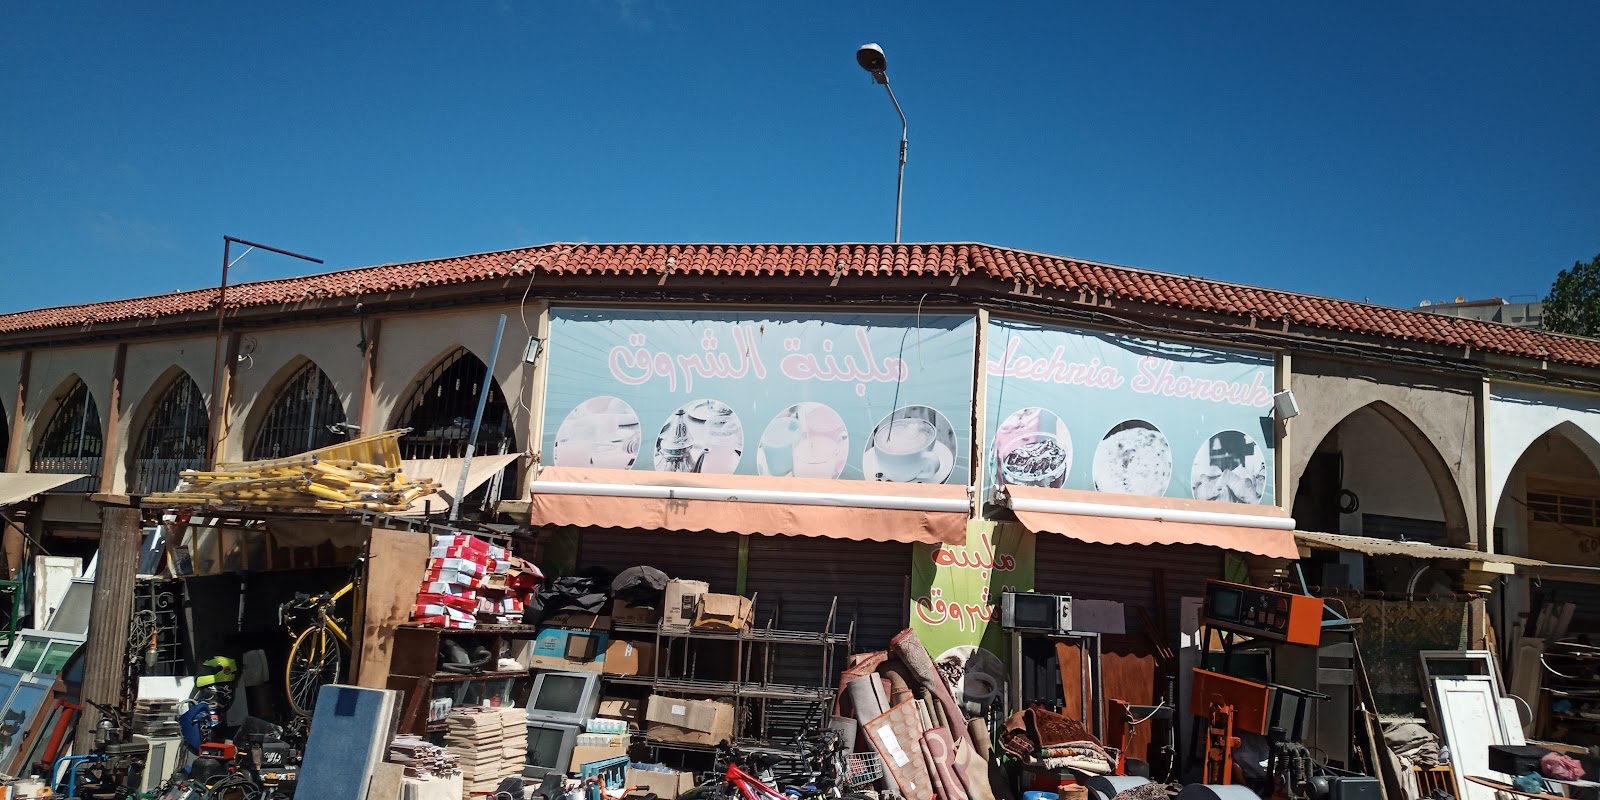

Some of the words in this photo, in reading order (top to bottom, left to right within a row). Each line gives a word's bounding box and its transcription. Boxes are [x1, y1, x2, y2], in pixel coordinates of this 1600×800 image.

[609, 325, 767, 393] الشروق
[780, 326, 909, 397] ملبنة
[1130, 355, 1274, 408] Shorouk
